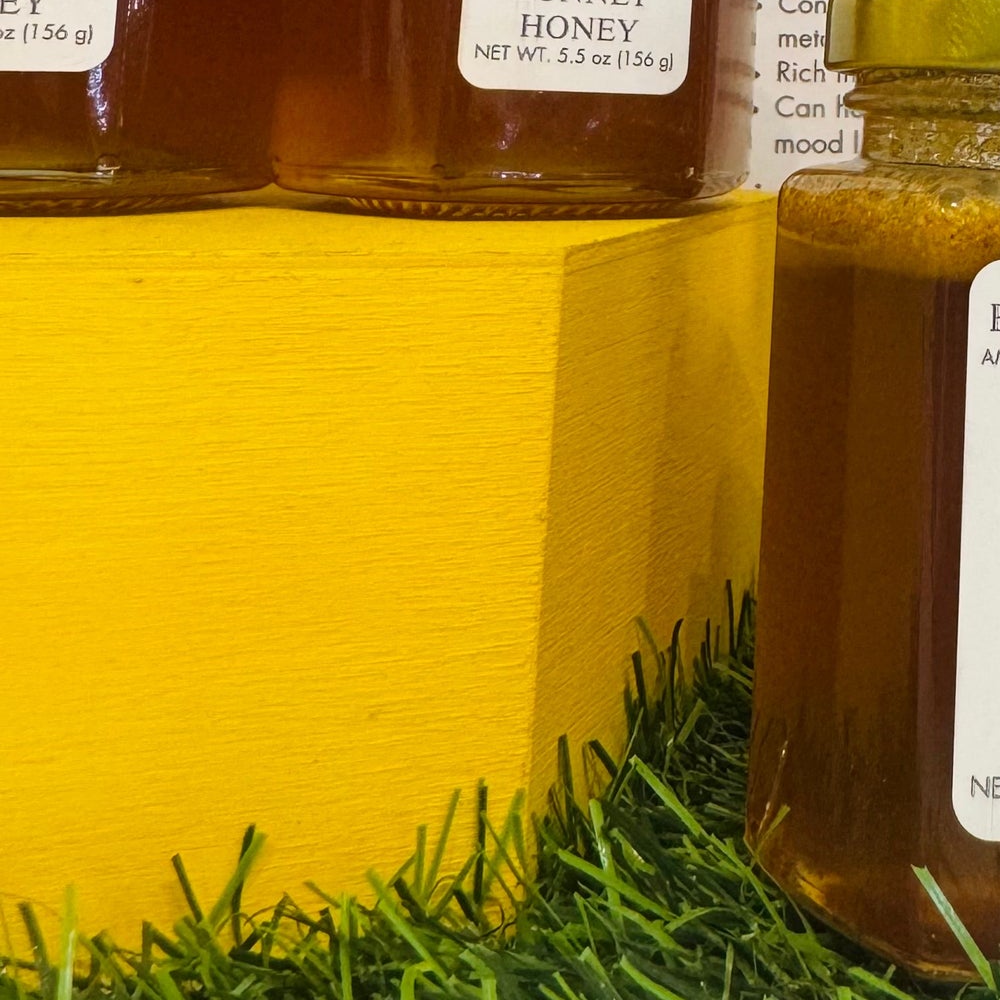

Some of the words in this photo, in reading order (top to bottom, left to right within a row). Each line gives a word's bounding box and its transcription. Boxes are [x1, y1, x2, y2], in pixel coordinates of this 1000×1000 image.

[23, 23, 69, 44] (156
[75, 24, 94, 45] g)
[520, 13, 640, 43] HONEY
[474, 43, 511, 61] NET
[517, 46, 550, 63] WT.
[557, 48, 586, 64] 5.5
[591, 54, 612, 66] oz
[617, 50, 654, 69] (156
[659, 53, 673, 72] g)
[776, 59, 826, 83] Rich
[775, 95, 825, 118] Can
[774, 130, 843, 154] mood
